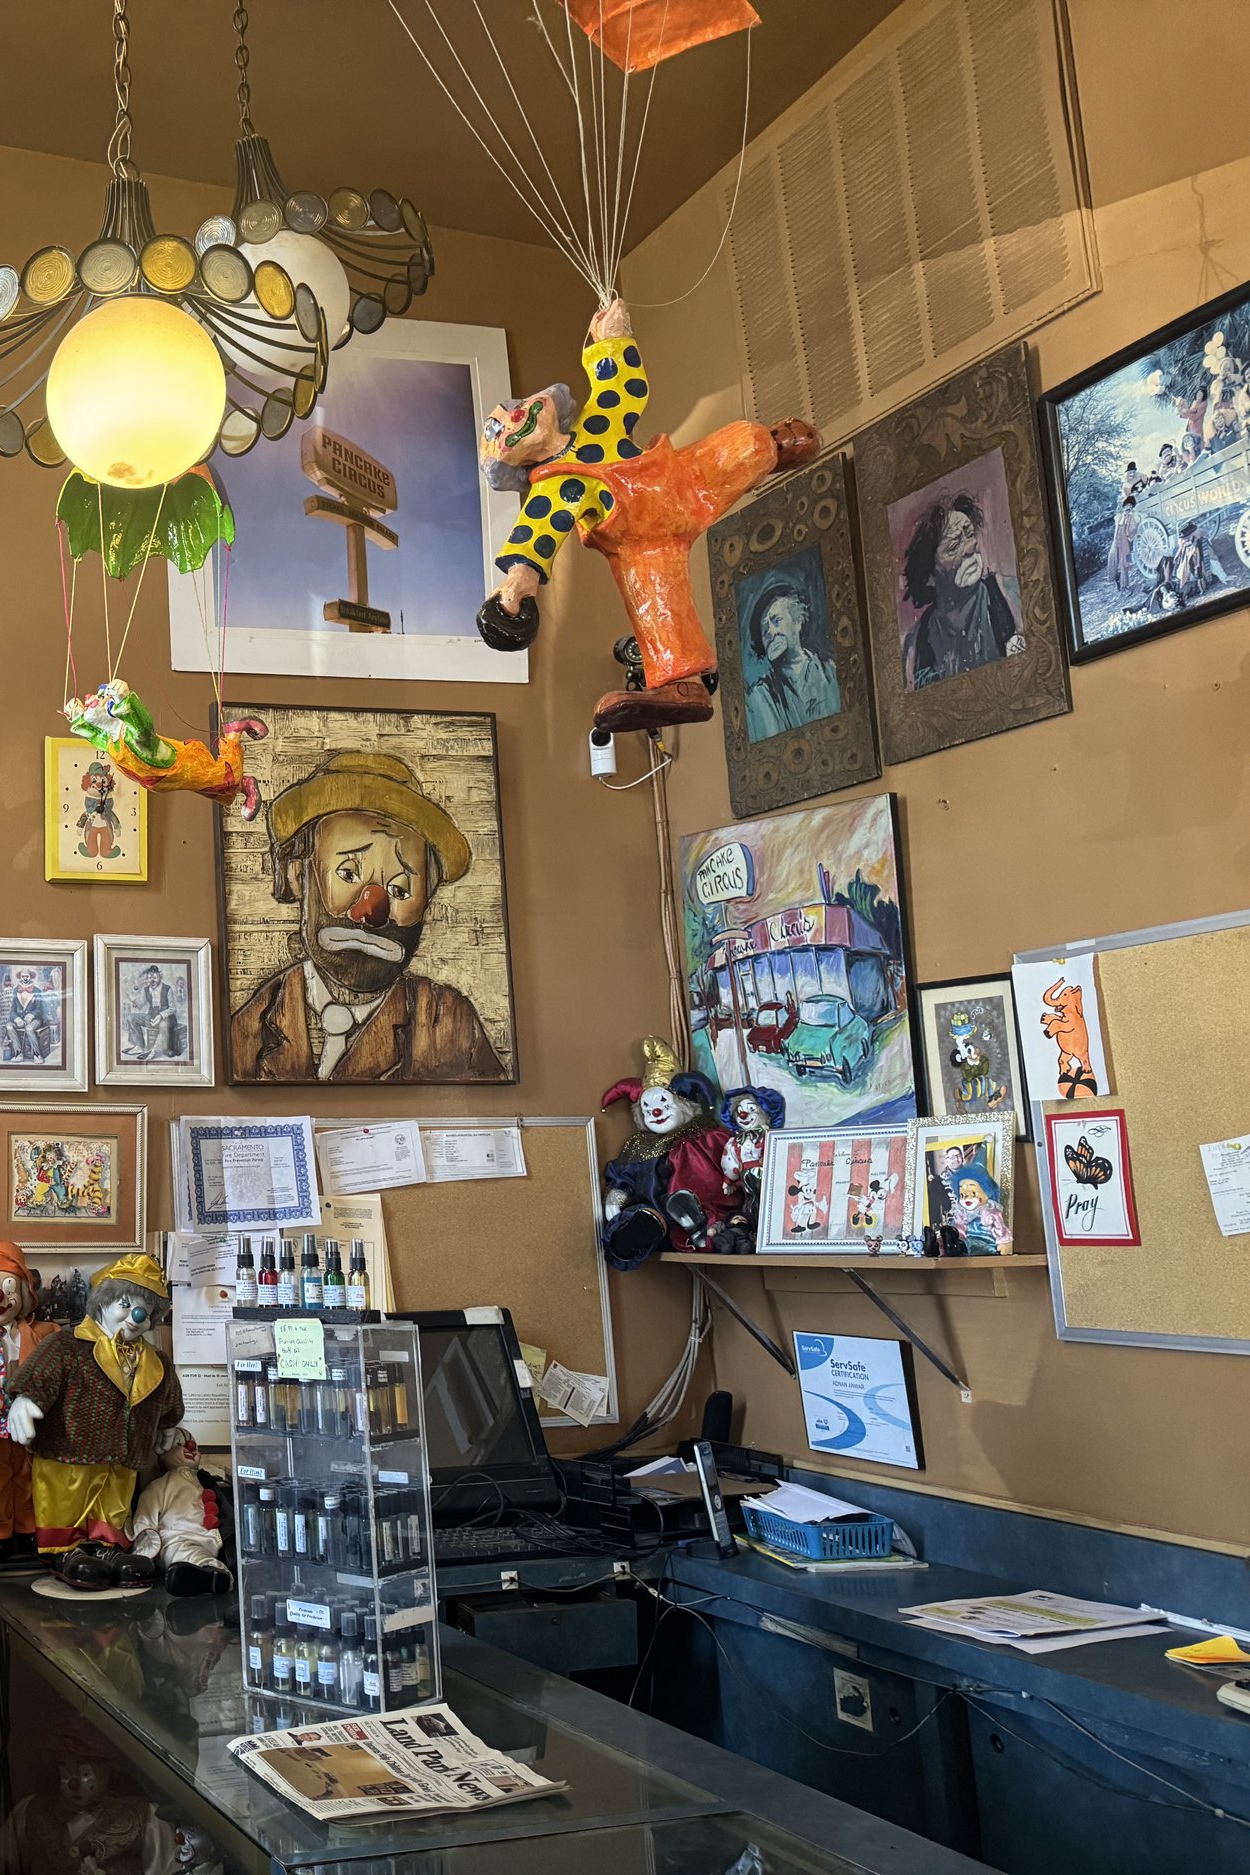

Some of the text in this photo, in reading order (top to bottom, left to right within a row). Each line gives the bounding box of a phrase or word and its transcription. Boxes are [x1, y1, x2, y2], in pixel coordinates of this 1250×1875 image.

[321, 433, 390, 487] PANCAKE
[331, 457, 385, 499] CIRCUS
[1165, 481, 1241, 517] CIRCUS WORLD
[95, 751, 105, 760] 12
[63, 804, 69, 813] 9
[131, 808, 137, 817] 3
[96, 861, 103, 871] 6
[698, 848, 735, 882] PANCAKE
[702, 867, 744, 898] CIRCUS
[802, 1158, 835, 1168] Pancake
[1065, 1193, 1105, 1232] Pray
[801, 1345, 821, 1353] ServSafe
[280, 1359, 298, 1368] CASH
[830, 1359, 866, 1372] ServSafe
[831, 1369, 870, 1381] CERTIFICATION
[380, 1717, 428, 1750] Land
[411, 1749, 458, 1778] Park
[452, 1770, 493, 1801] News
[418, 1783, 436, 1792] Grief
